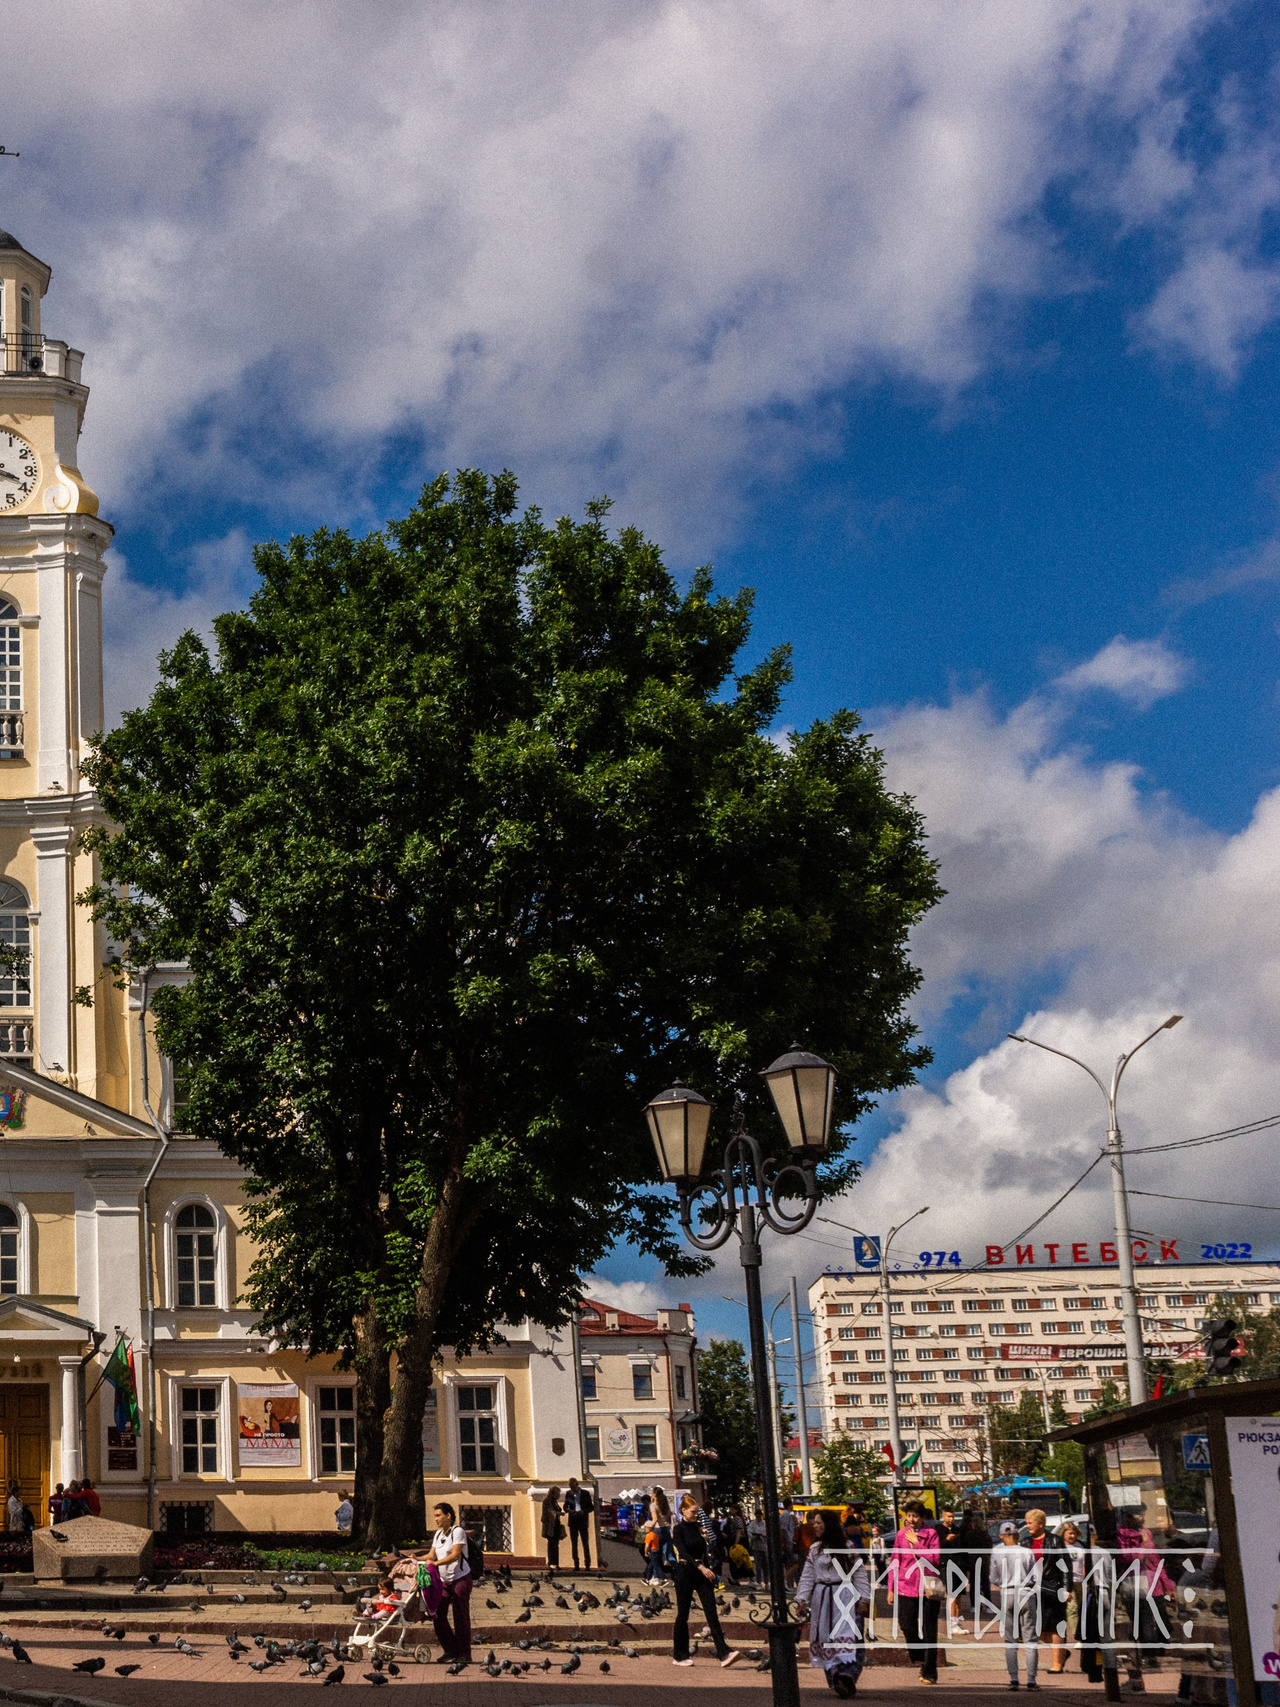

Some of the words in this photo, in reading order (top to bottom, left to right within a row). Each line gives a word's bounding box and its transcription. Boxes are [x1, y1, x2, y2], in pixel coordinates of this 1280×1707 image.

[9, 436, 13, 447] 1
[19, 449, 28, 459] 2
[24, 466, 34, 477] 3
[18, 482, 28, 492] 4
[6, 494, 15, 504] 5
[919, 1251, 962, 1267] 974
[985, 1239, 1180, 1266] ВИТЕБСК
[1201, 1243, 1252, 1259] 2022
[1008, 1345, 1053, 1355] ШИНЫ
[246, 1438, 294, 1449] МАМА
